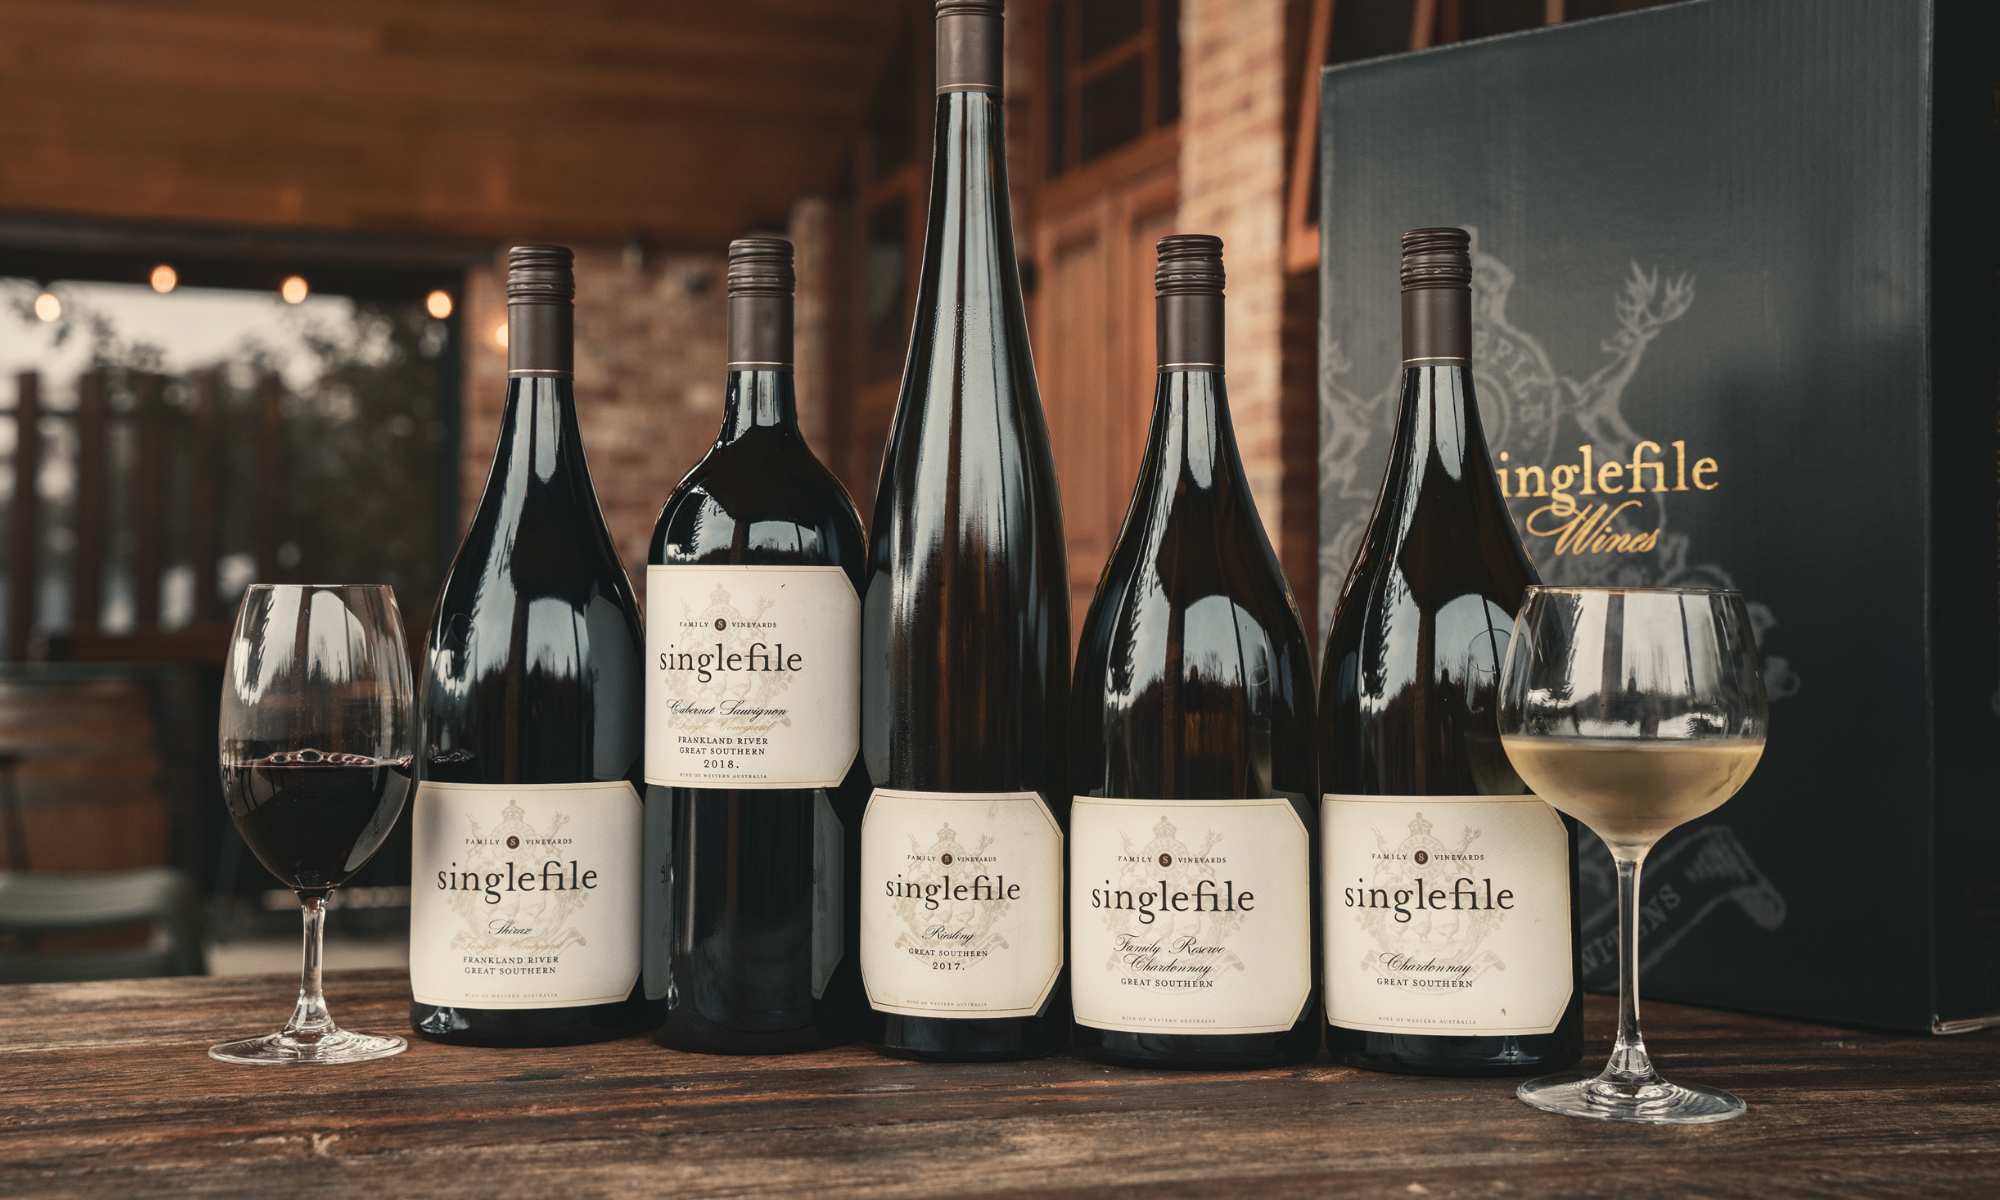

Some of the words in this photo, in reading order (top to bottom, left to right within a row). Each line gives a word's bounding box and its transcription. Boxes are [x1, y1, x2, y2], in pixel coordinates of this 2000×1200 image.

[1496, 440, 1719, 518] inglefile
[1526, 500, 1661, 556] Wines
[659, 642, 802, 684] singlefile
[666, 699, 716, 715] Cabernet
[720, 700, 789, 722] Sauvignon
[674, 716, 711, 735] Single
[714, 716, 777, 736] Vineyard
[678, 736, 733, 745] FRANKLAND
[737, 737, 769, 745] RIVER
[679, 747, 707, 755] GREAT
[710, 747, 765, 756] SOUTHERN
[703, 760, 740, 769] 2018.
[1118, 855, 1153, 863] FAMILY
[437, 860, 598, 904] singlefile
[886, 873, 1020, 910] singlefile
[1092, 879, 1255, 925] singlefile
[1344, 877, 1515, 923] singlefile
[488, 919, 533, 935] Shiraz
[921, 925, 976, 946] Riesling
[459, 936, 501, 956] Single
[504, 936, 567, 956] Vineyard
[908, 948, 935, 956] GREAT
[1113, 933, 1162, 956] Family
[1168, 936, 1226, 955] Reserve
[463, 956, 523, 964] FRANKLAND
[528, 956, 559, 964] RIVER
[932, 962, 965, 971] 2017.
[1123, 954, 1213, 981] Chardonnay
[1379, 952, 1472, 981] Chardonnay
[464, 966, 495, 975] GREAT
[499, 966, 556, 975] SOUTHERN
[1120, 978, 1151, 986] GREAT
[1155, 979, 1213, 988] SOUTHERN
[1376, 977, 1409, 987] GREAT
[1412, 979, 1473, 988] SOUTHERN
